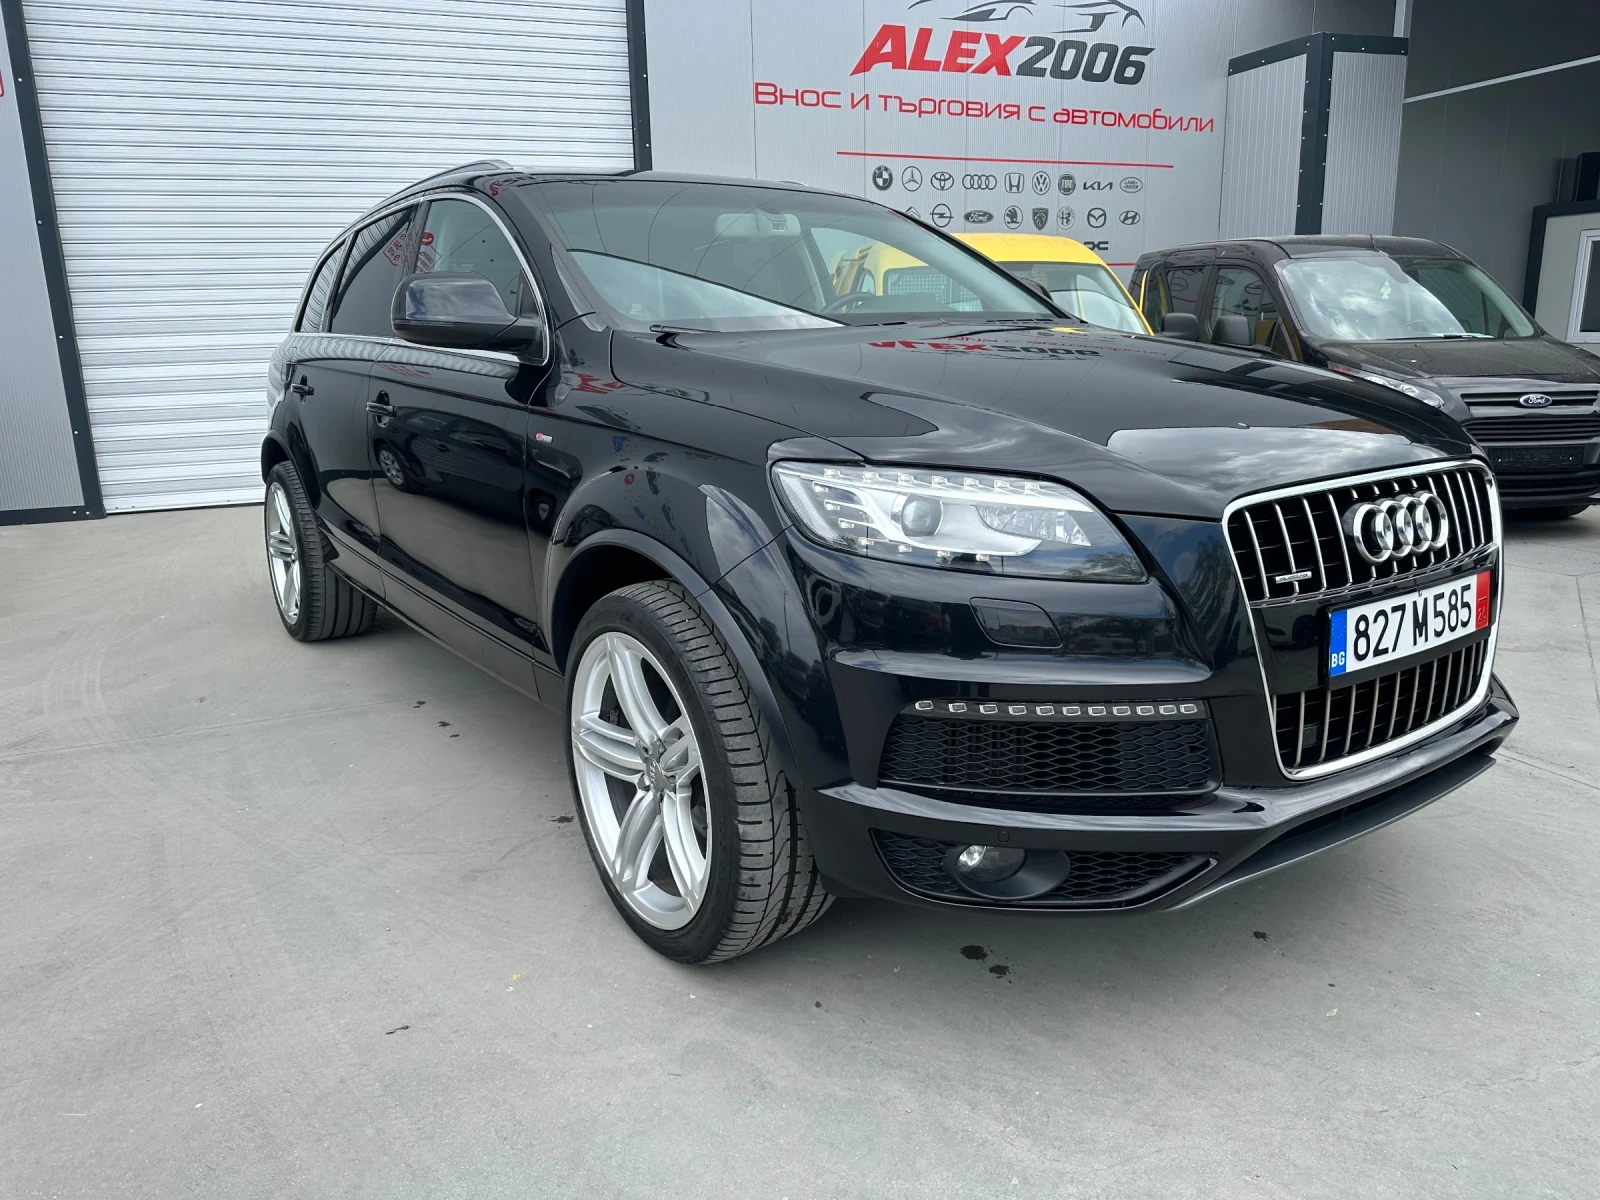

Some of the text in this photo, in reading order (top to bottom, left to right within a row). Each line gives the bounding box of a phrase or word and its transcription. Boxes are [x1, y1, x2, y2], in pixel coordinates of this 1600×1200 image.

[849, 24, 1156, 85] ALEX2006
[754, 82, 1214, 133] Внос и търговия с автомобили
[968, 211, 989, 222] Ford
[1331, 651, 1345, 668] BG
